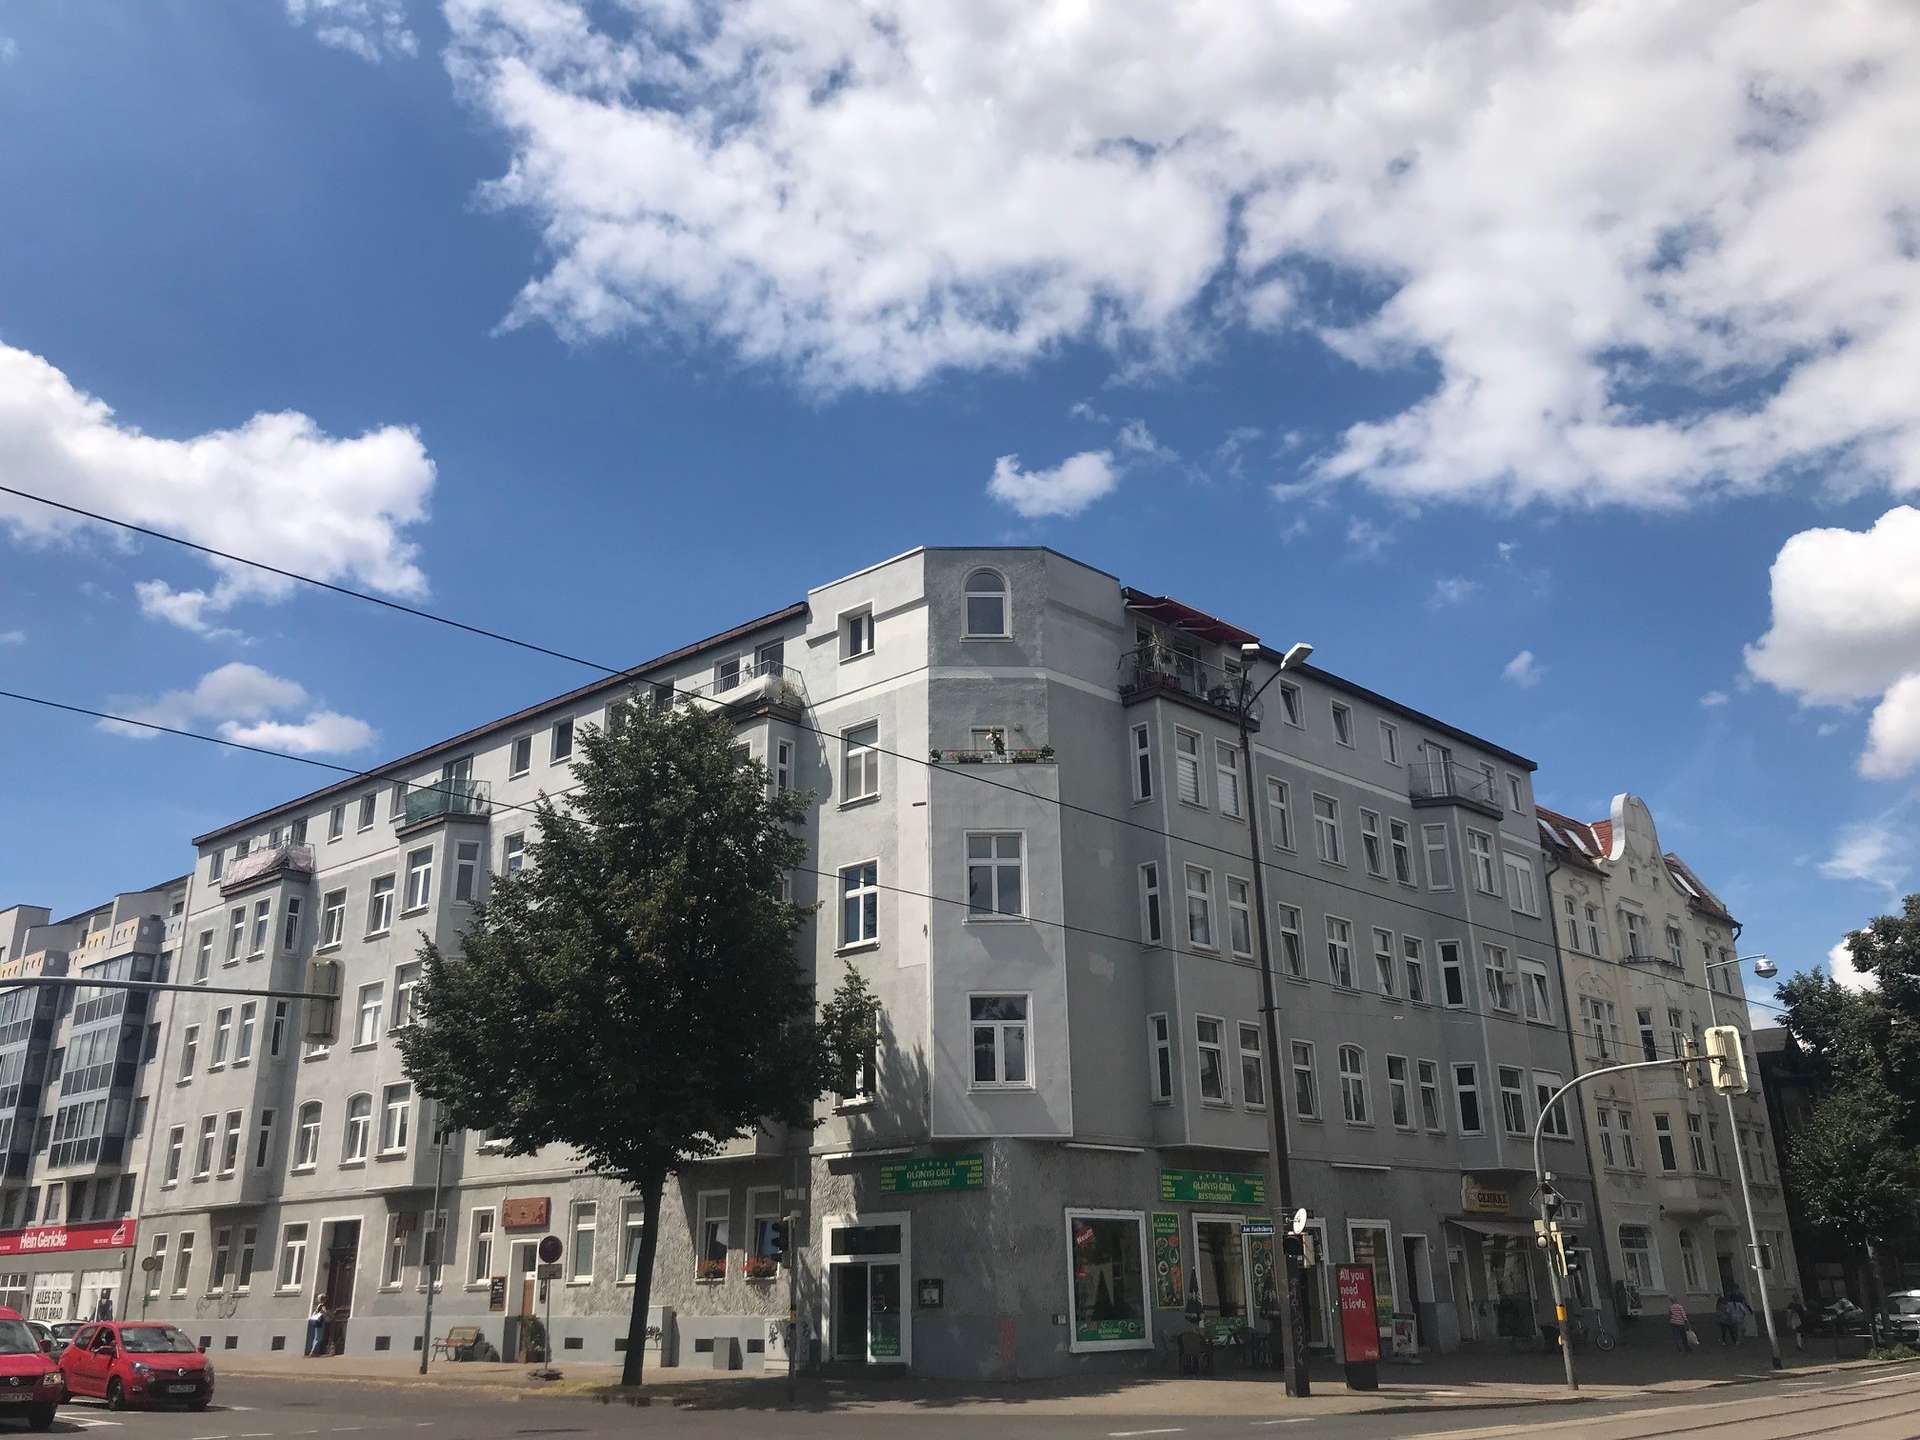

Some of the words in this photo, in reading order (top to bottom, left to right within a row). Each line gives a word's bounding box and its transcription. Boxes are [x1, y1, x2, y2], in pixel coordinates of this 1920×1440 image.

[20, 1232, 37, 1248] Hein
[37, 1230, 67, 1248] Gericke
[1340, 1269, 1349, 1280] All
[1350, 1272, 1365, 1284] you
[1340, 1283, 1359, 1295] need
[35, 1291, 51, 1304] ALLES
[1342, 1299, 1348, 1310] is
[1349, 1298, 1367, 1309] love
